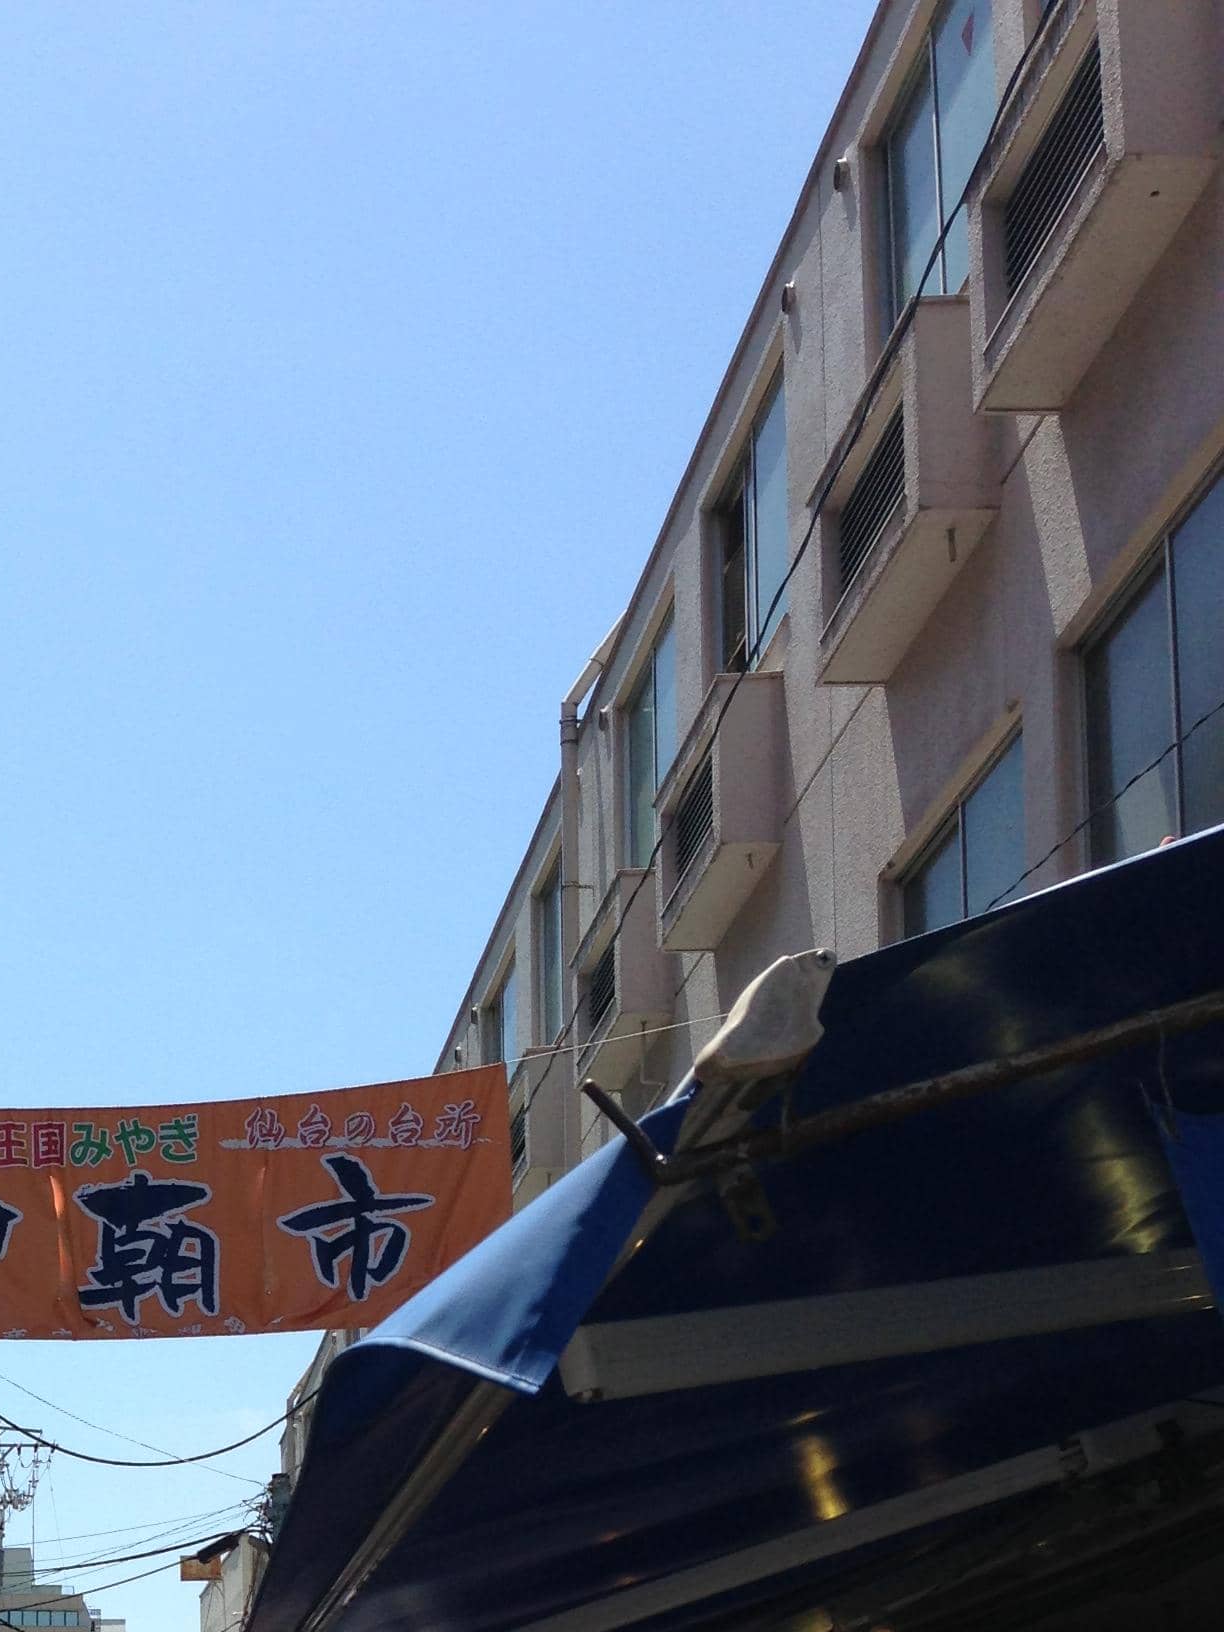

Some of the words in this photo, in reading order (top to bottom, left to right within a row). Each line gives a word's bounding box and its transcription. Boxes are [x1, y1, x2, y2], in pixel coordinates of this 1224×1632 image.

[244, 1100, 481, 1150] 仙台の台所
